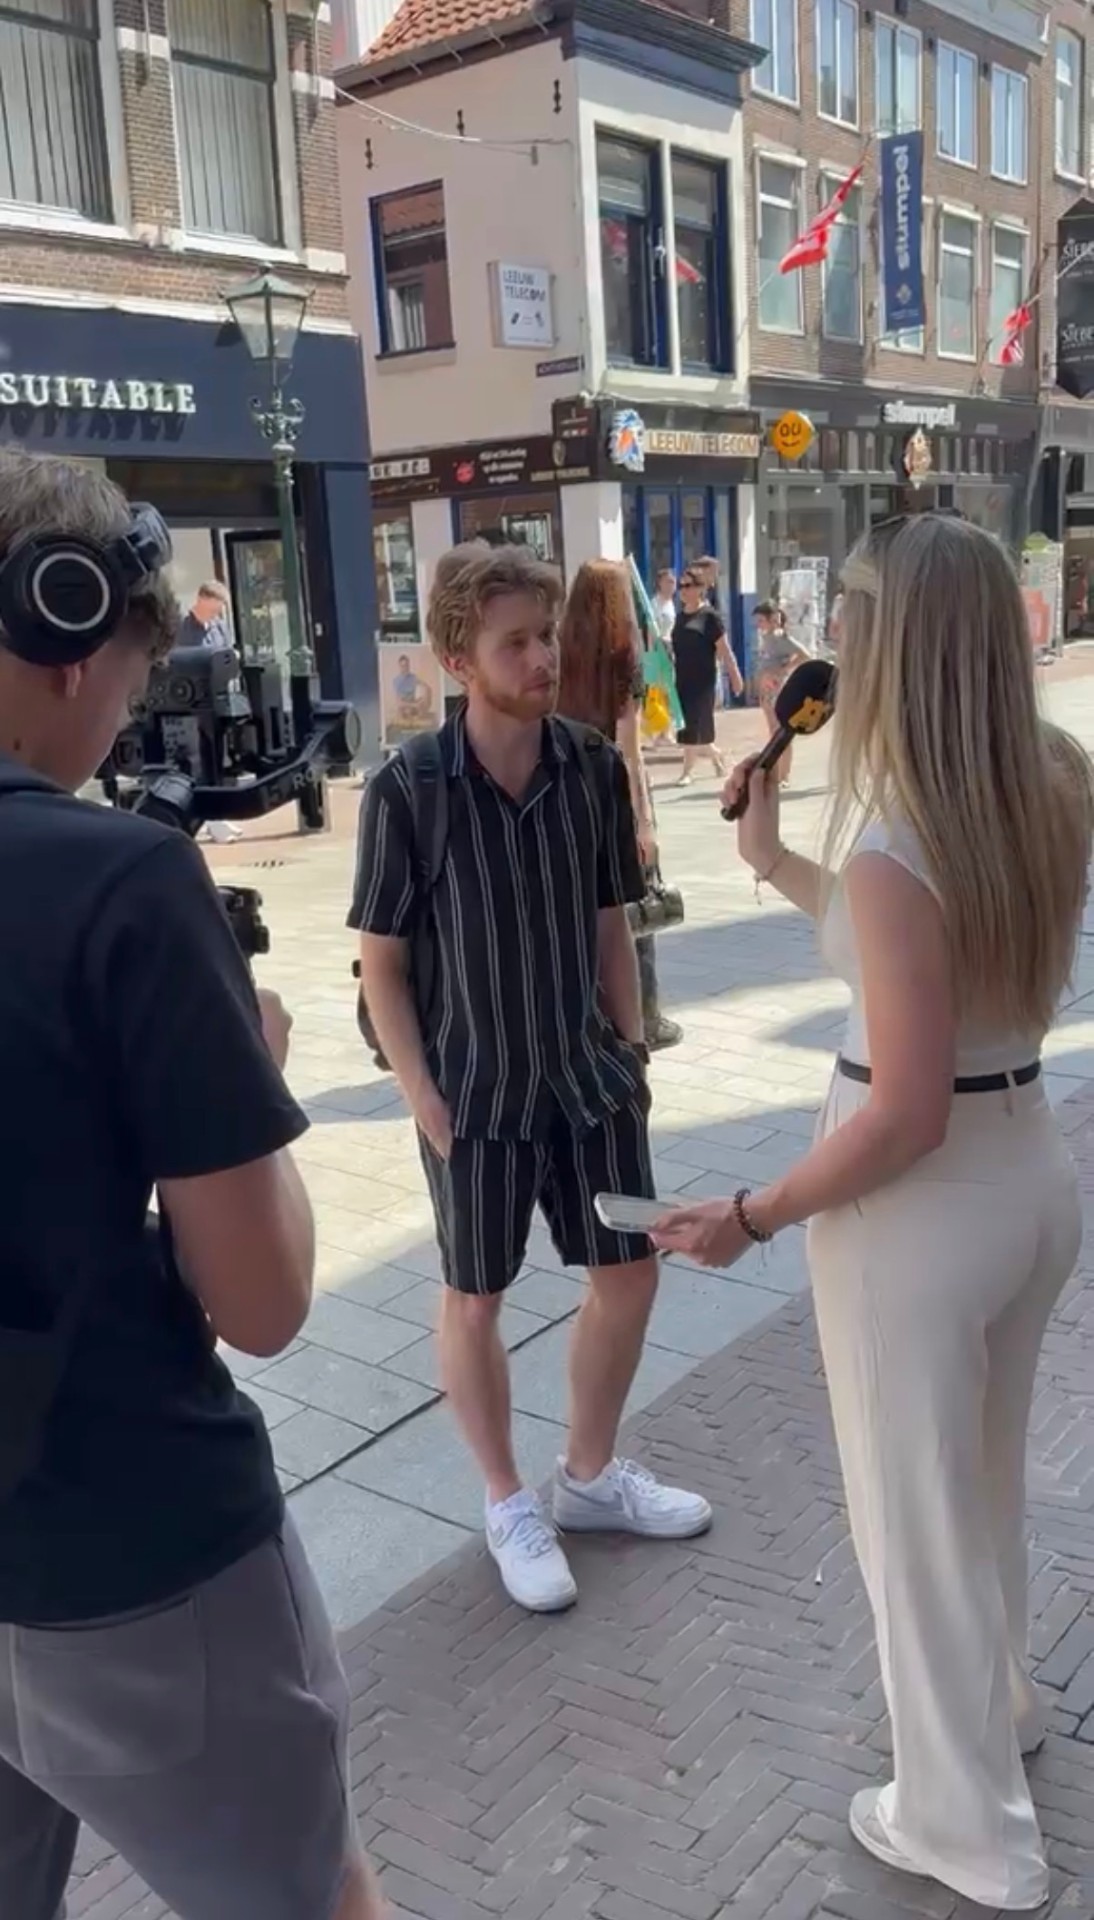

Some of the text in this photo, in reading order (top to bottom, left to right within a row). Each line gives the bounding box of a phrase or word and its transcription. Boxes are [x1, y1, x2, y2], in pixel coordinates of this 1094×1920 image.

[893, 144, 910, 270] stumpel
[503, 270, 535, 286] LEEUW
[504, 285, 546, 302] TELECOM
[0, 372, 196, 413] SUITABLE
[650, 434, 757, 454] LEEUW TELECOM
